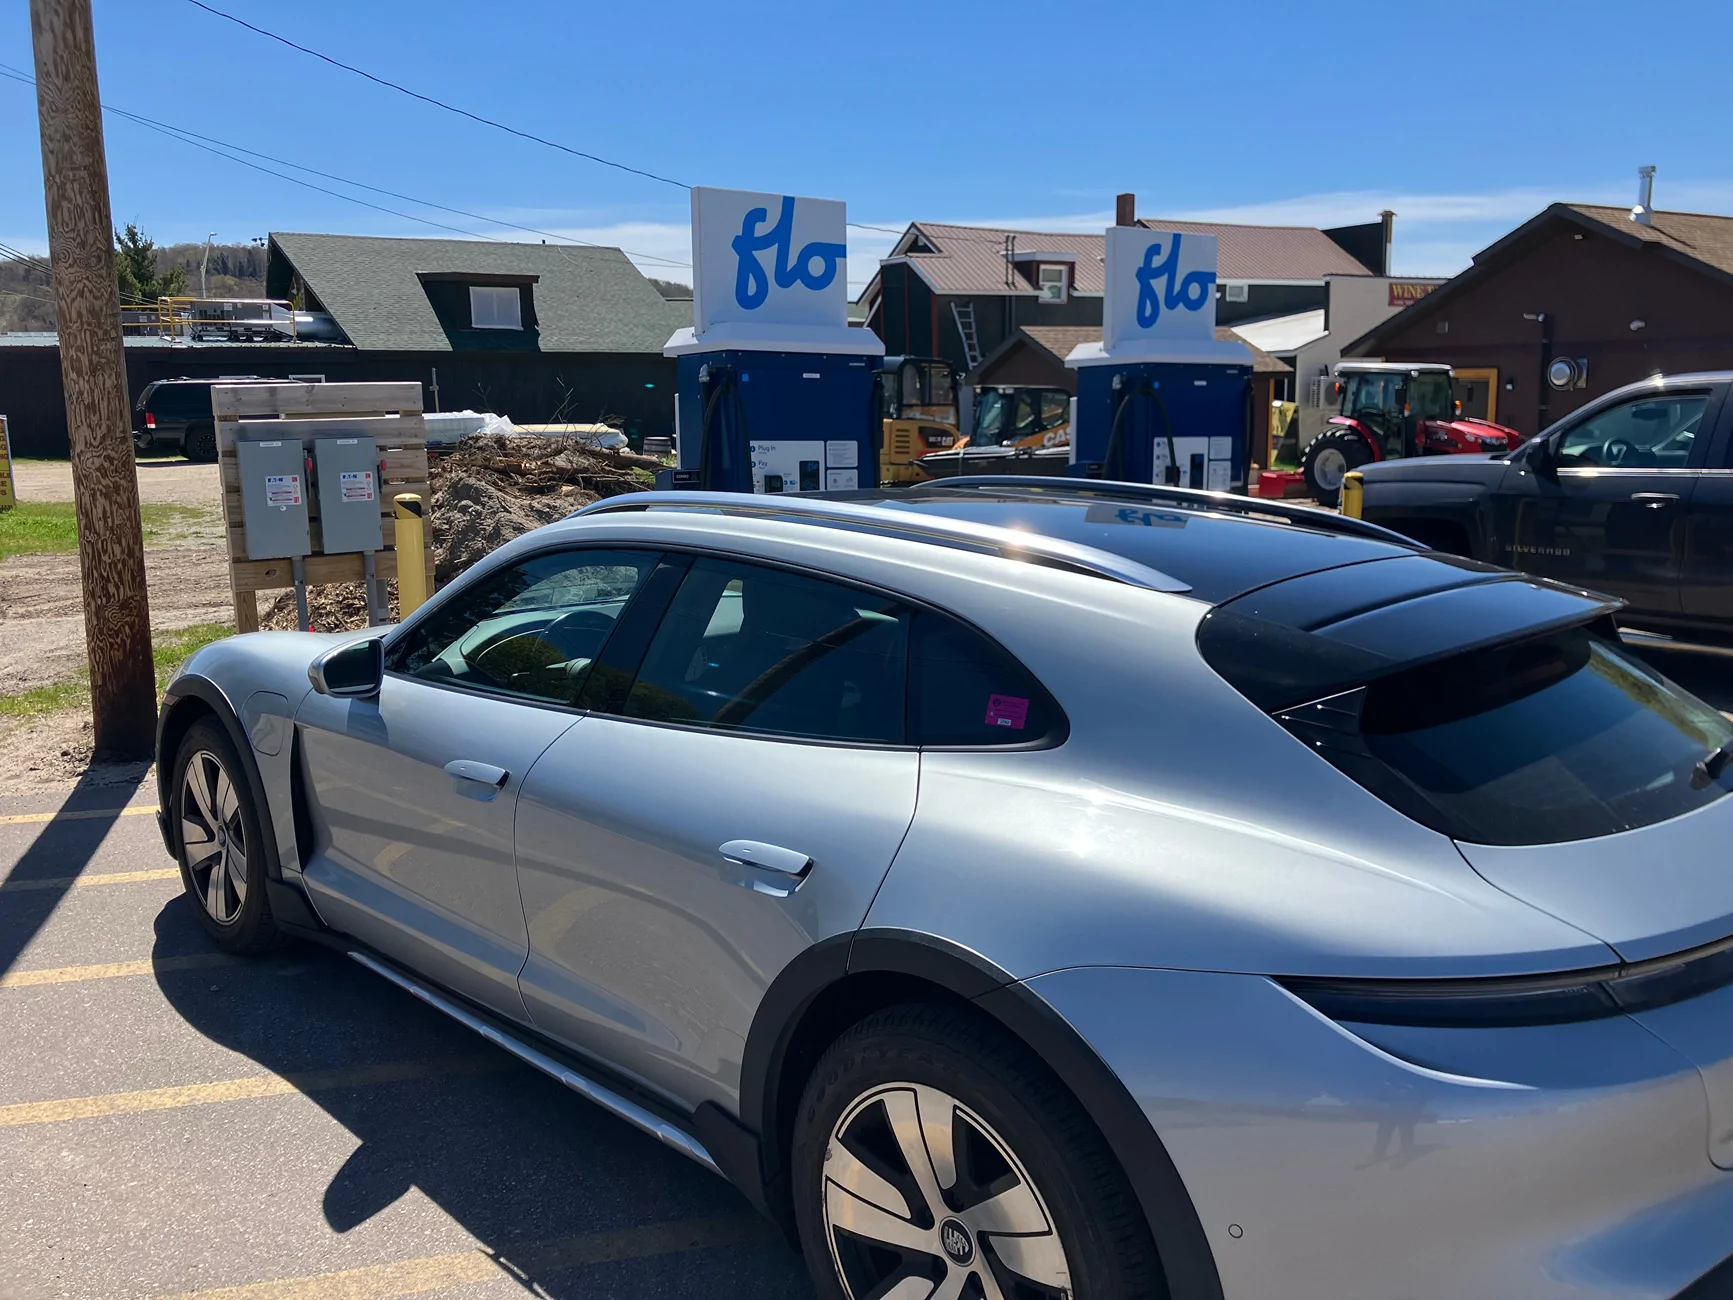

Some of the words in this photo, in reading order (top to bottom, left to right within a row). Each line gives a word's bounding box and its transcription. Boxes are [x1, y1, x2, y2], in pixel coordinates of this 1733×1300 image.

[731, 195, 847, 310] flo
[1136, 233, 1217, 329] flo
[1392, 284, 1424, 299] WINE
